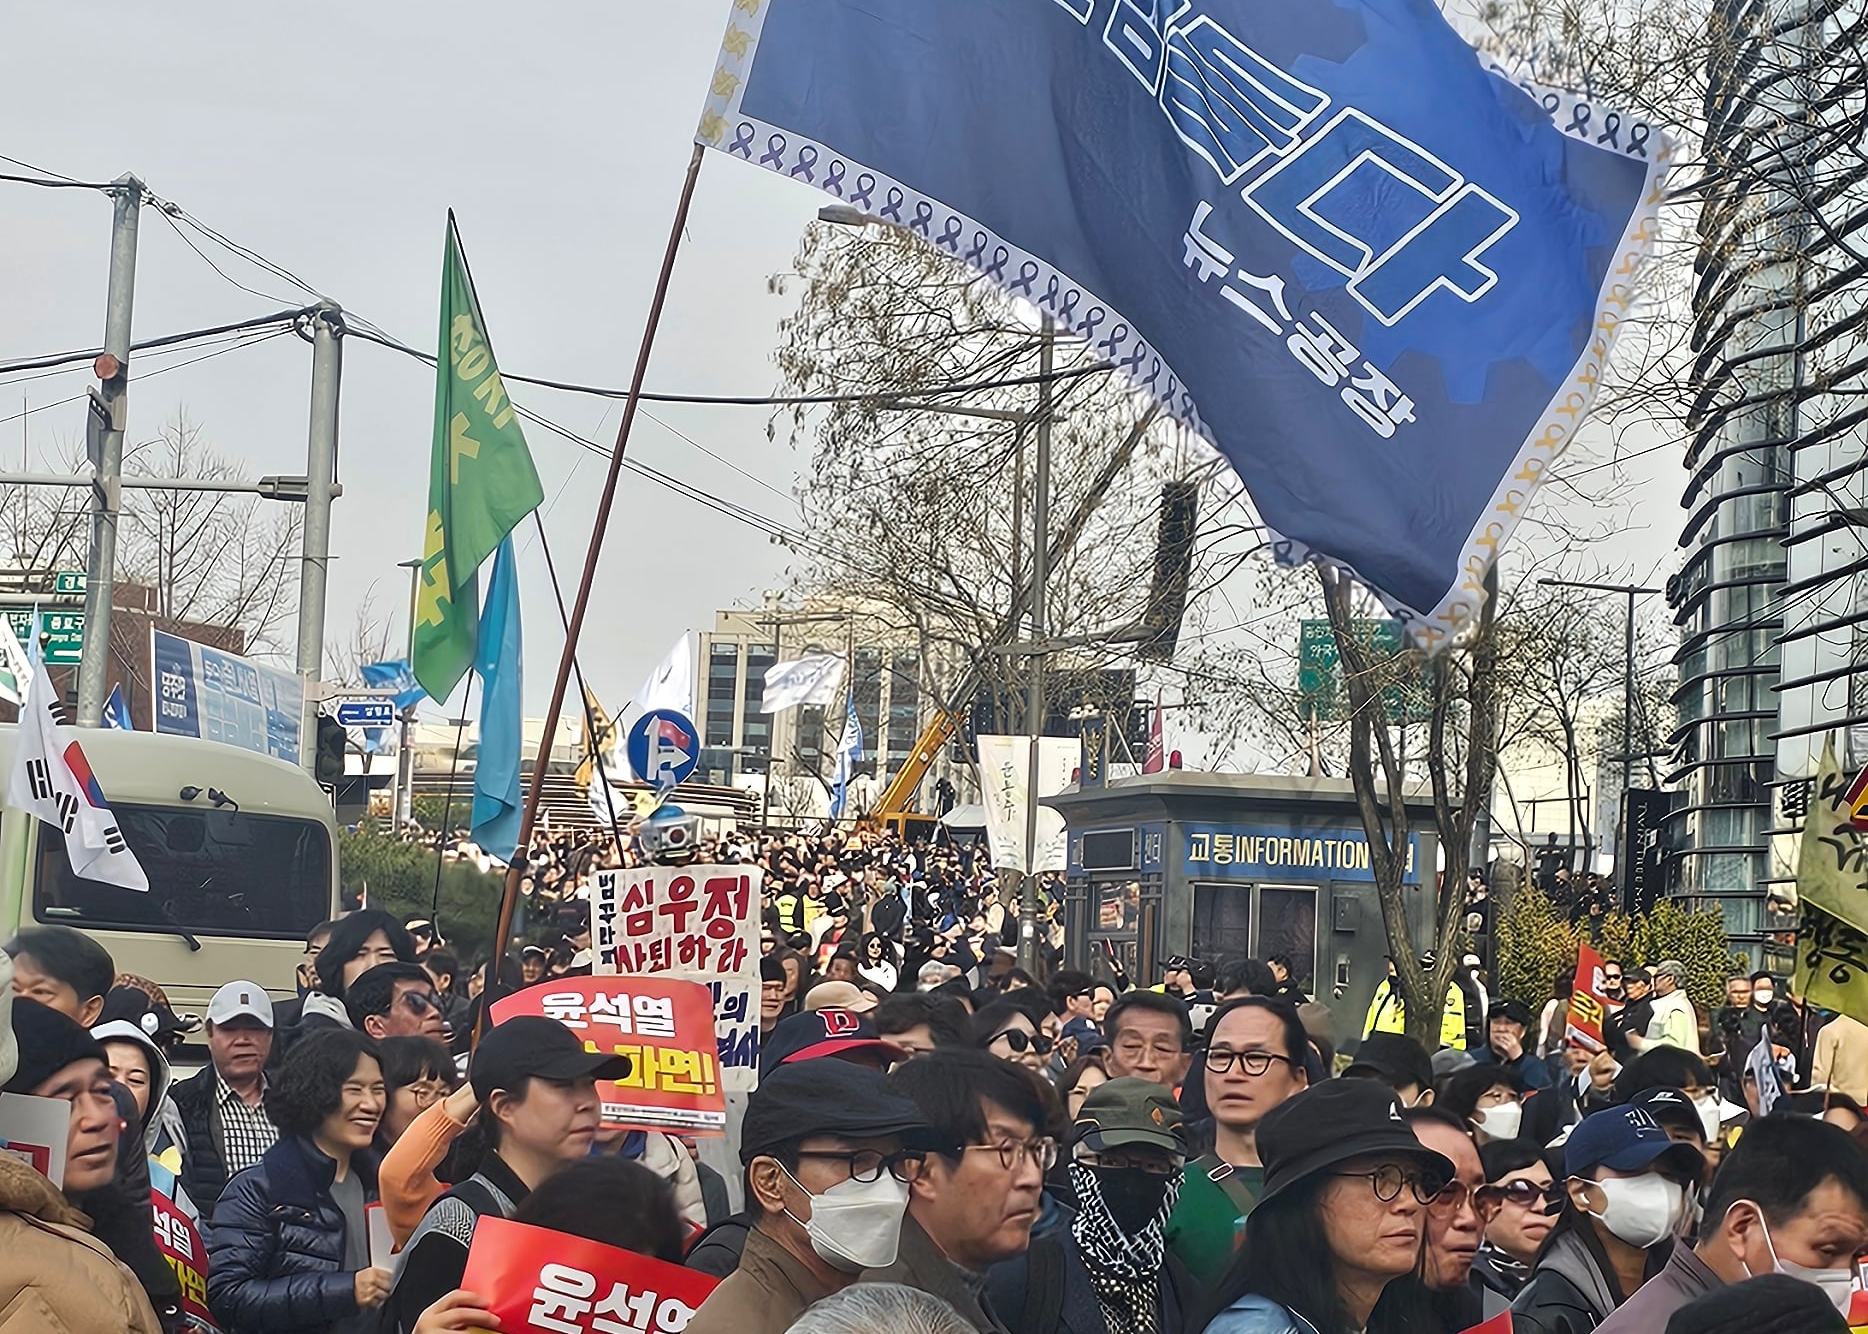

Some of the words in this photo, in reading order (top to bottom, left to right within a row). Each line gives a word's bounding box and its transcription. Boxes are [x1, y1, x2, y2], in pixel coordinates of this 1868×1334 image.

[1183, 200, 1418, 438] 뉴스공장
[1188, 833, 1414, 873] 교통INFORMATION
[621, 875, 750, 939] 심우정
[616, 934, 748, 974] 사퇴하라
[541, 991, 676, 1038] 윤석열
[153, 1204, 194, 1263] 석열
